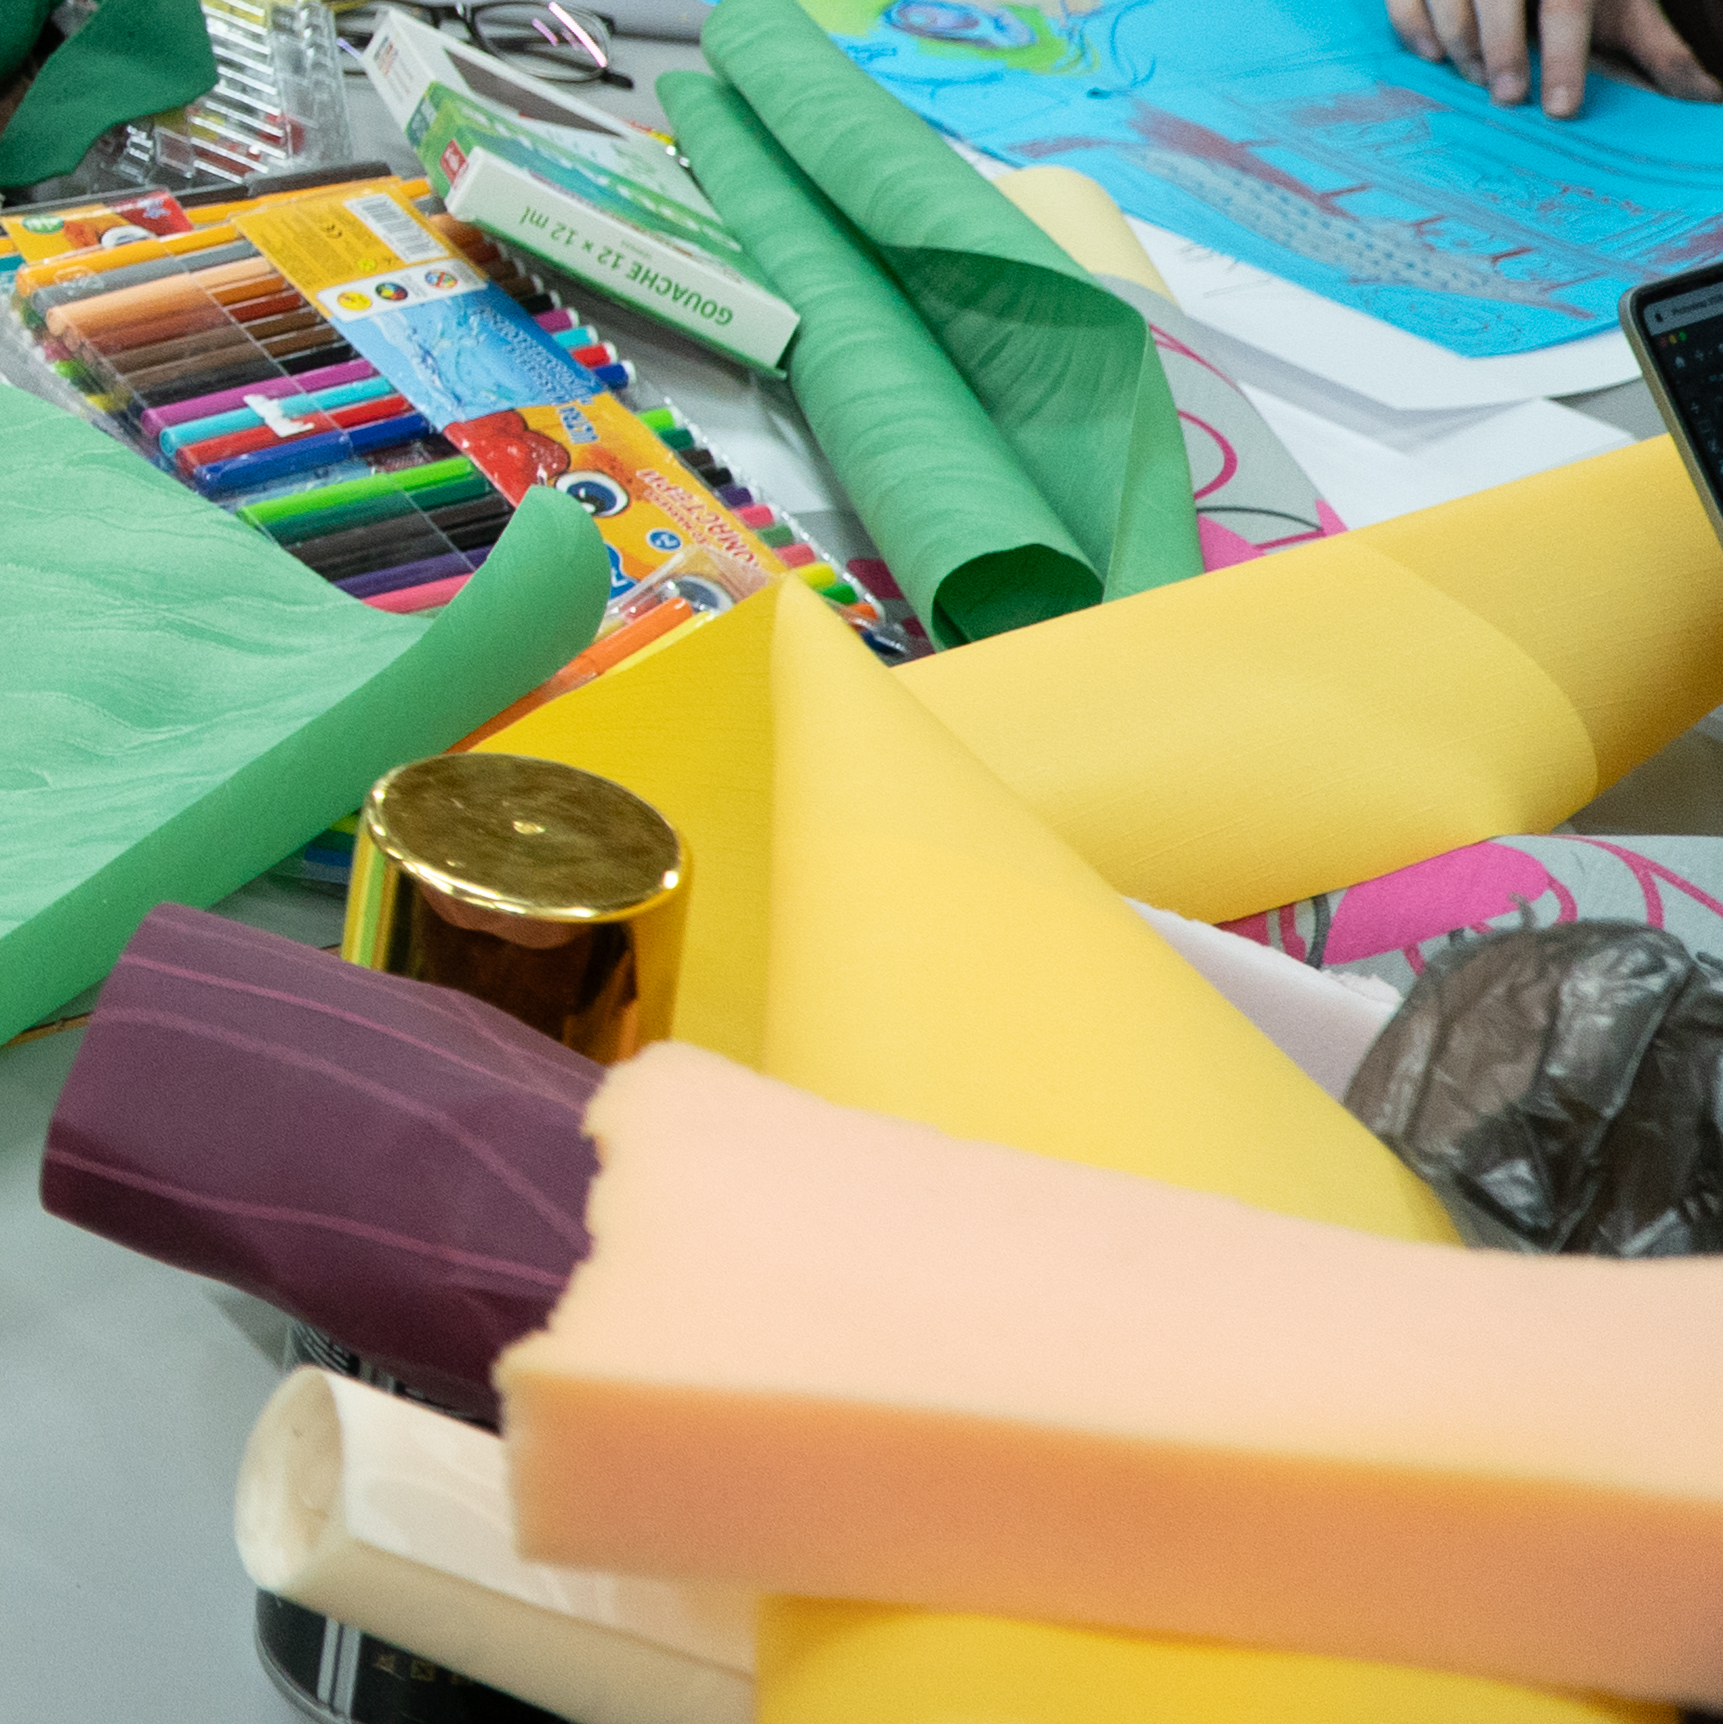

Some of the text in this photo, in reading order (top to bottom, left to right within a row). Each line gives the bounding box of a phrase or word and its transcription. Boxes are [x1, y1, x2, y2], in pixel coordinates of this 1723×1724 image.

[518, 205, 551, 231] ml
[549, 220, 579, 248] 12
[596, 245, 623, 271] 12
[628, 259, 734, 327] GOUACHE
